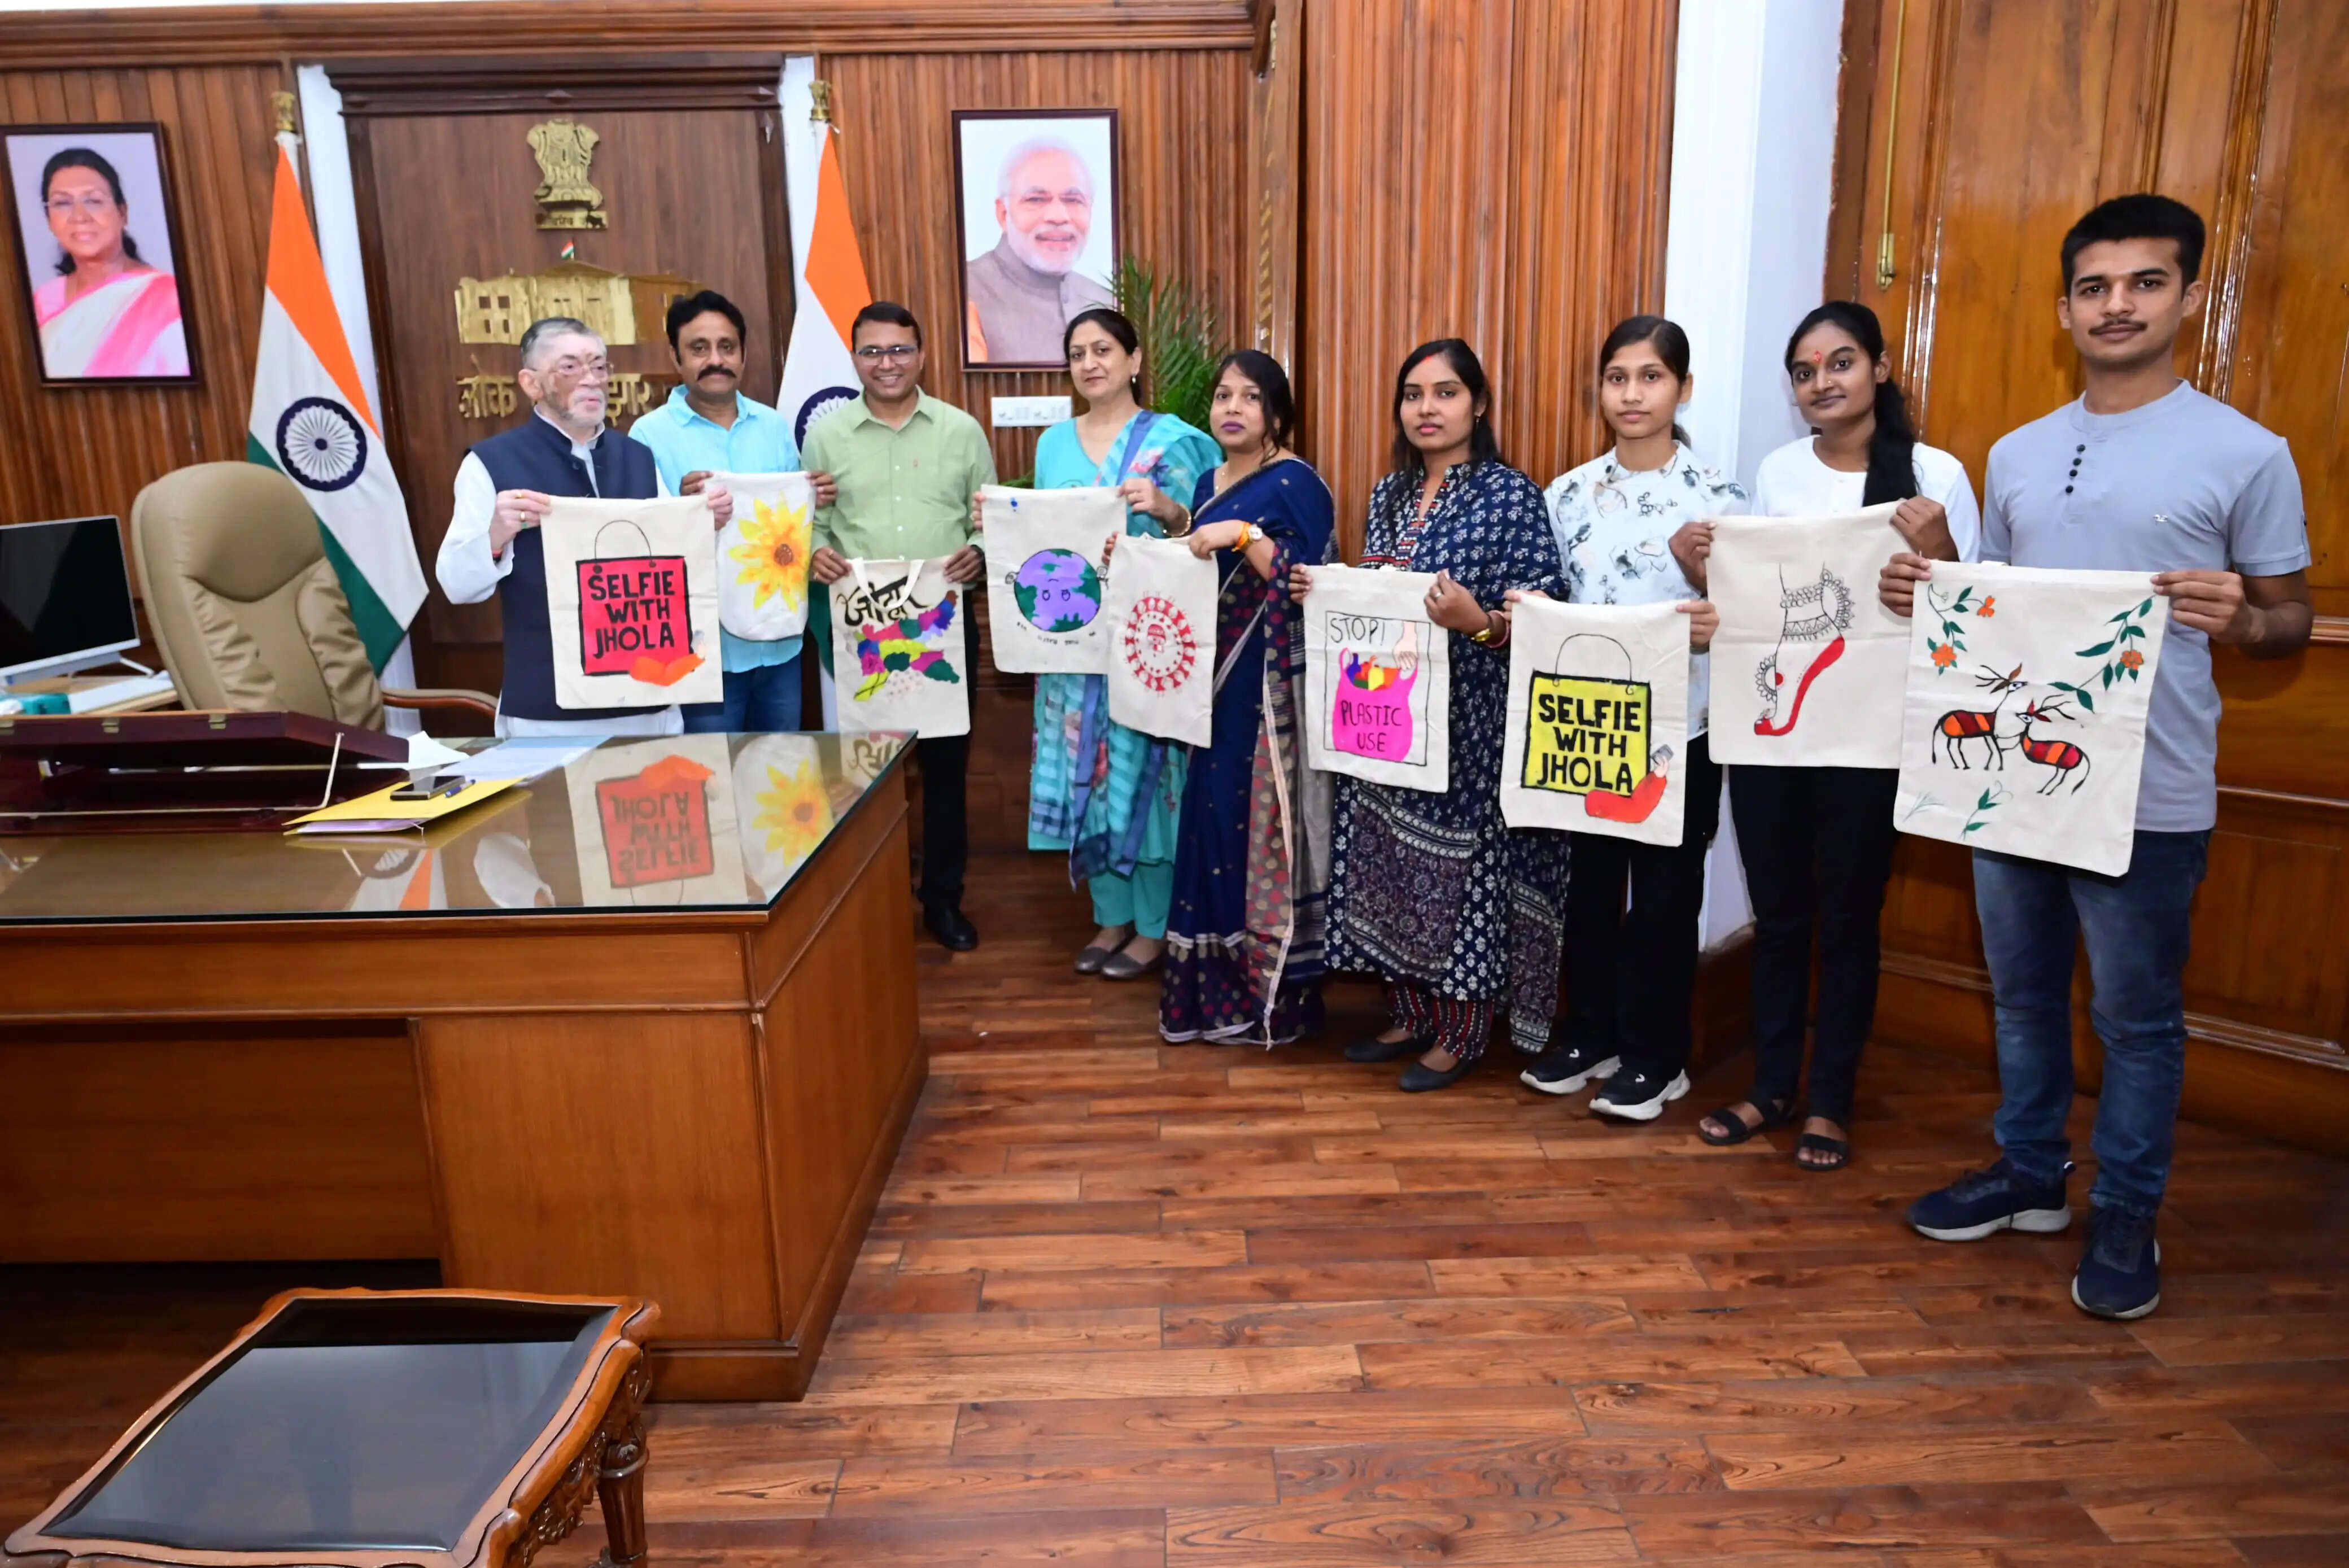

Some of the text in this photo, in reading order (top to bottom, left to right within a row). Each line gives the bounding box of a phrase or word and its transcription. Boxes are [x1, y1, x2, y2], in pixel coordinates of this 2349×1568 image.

[588, 570, 675, 600] SELFIE
[605, 599, 671, 623] WITH
[593, 622, 675, 659] JHOLA
[1330, 617, 1385, 646] STOP!
[1340, 700, 1402, 727] PLASTIC
[1539, 693, 1641, 732] SELFIE
[1357, 732, 1387, 752] USE
[1553, 726, 1627, 758] WITH
[1536, 753, 1632, 793] JHOLA
